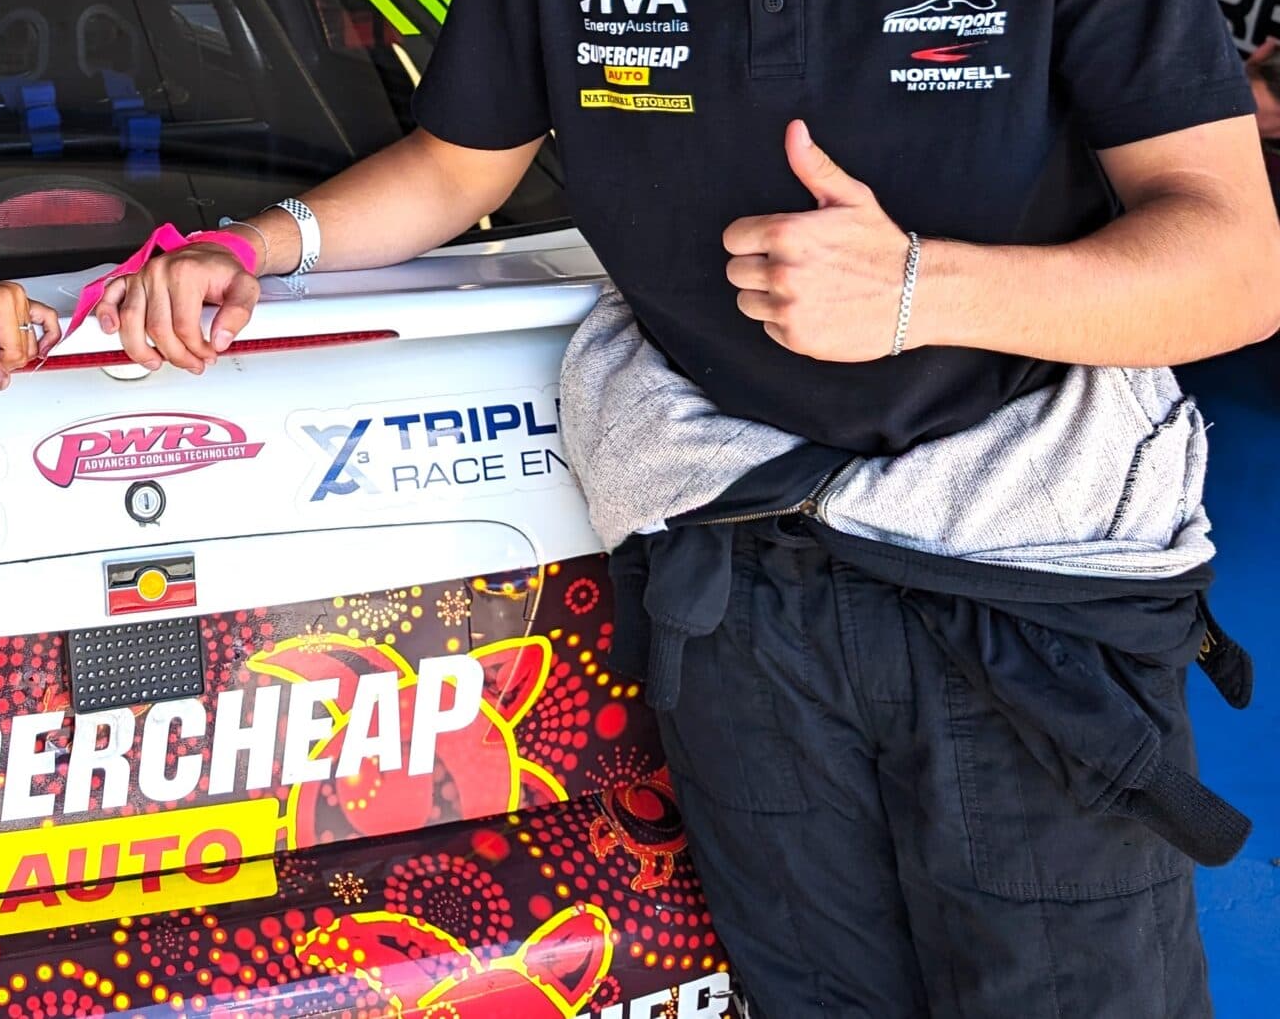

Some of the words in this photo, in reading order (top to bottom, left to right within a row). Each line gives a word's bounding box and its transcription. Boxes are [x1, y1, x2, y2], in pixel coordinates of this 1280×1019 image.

[584, 18, 690, 35] EnergyAustralia
[882, 11, 1008, 36] motorsport
[577, 42, 690, 69] SUPERCHEAP
[608, 71, 643, 81] AUTO
[891, 66, 1011, 83] NORWELL
[907, 80, 993, 92] MOTORPLEX
[584, 94, 631, 107] NATIONAL
[635, 96, 688, 109] STORAGE
[384, 398, 561, 450] TRIPL
[46, 423, 211, 488] PWR
[84, 456, 137, 471] ADVANCED
[140, 451, 181, 466] COOLING
[184, 446, 246, 461] TECHNOLOGY
[392, 454, 506, 492] RACE
